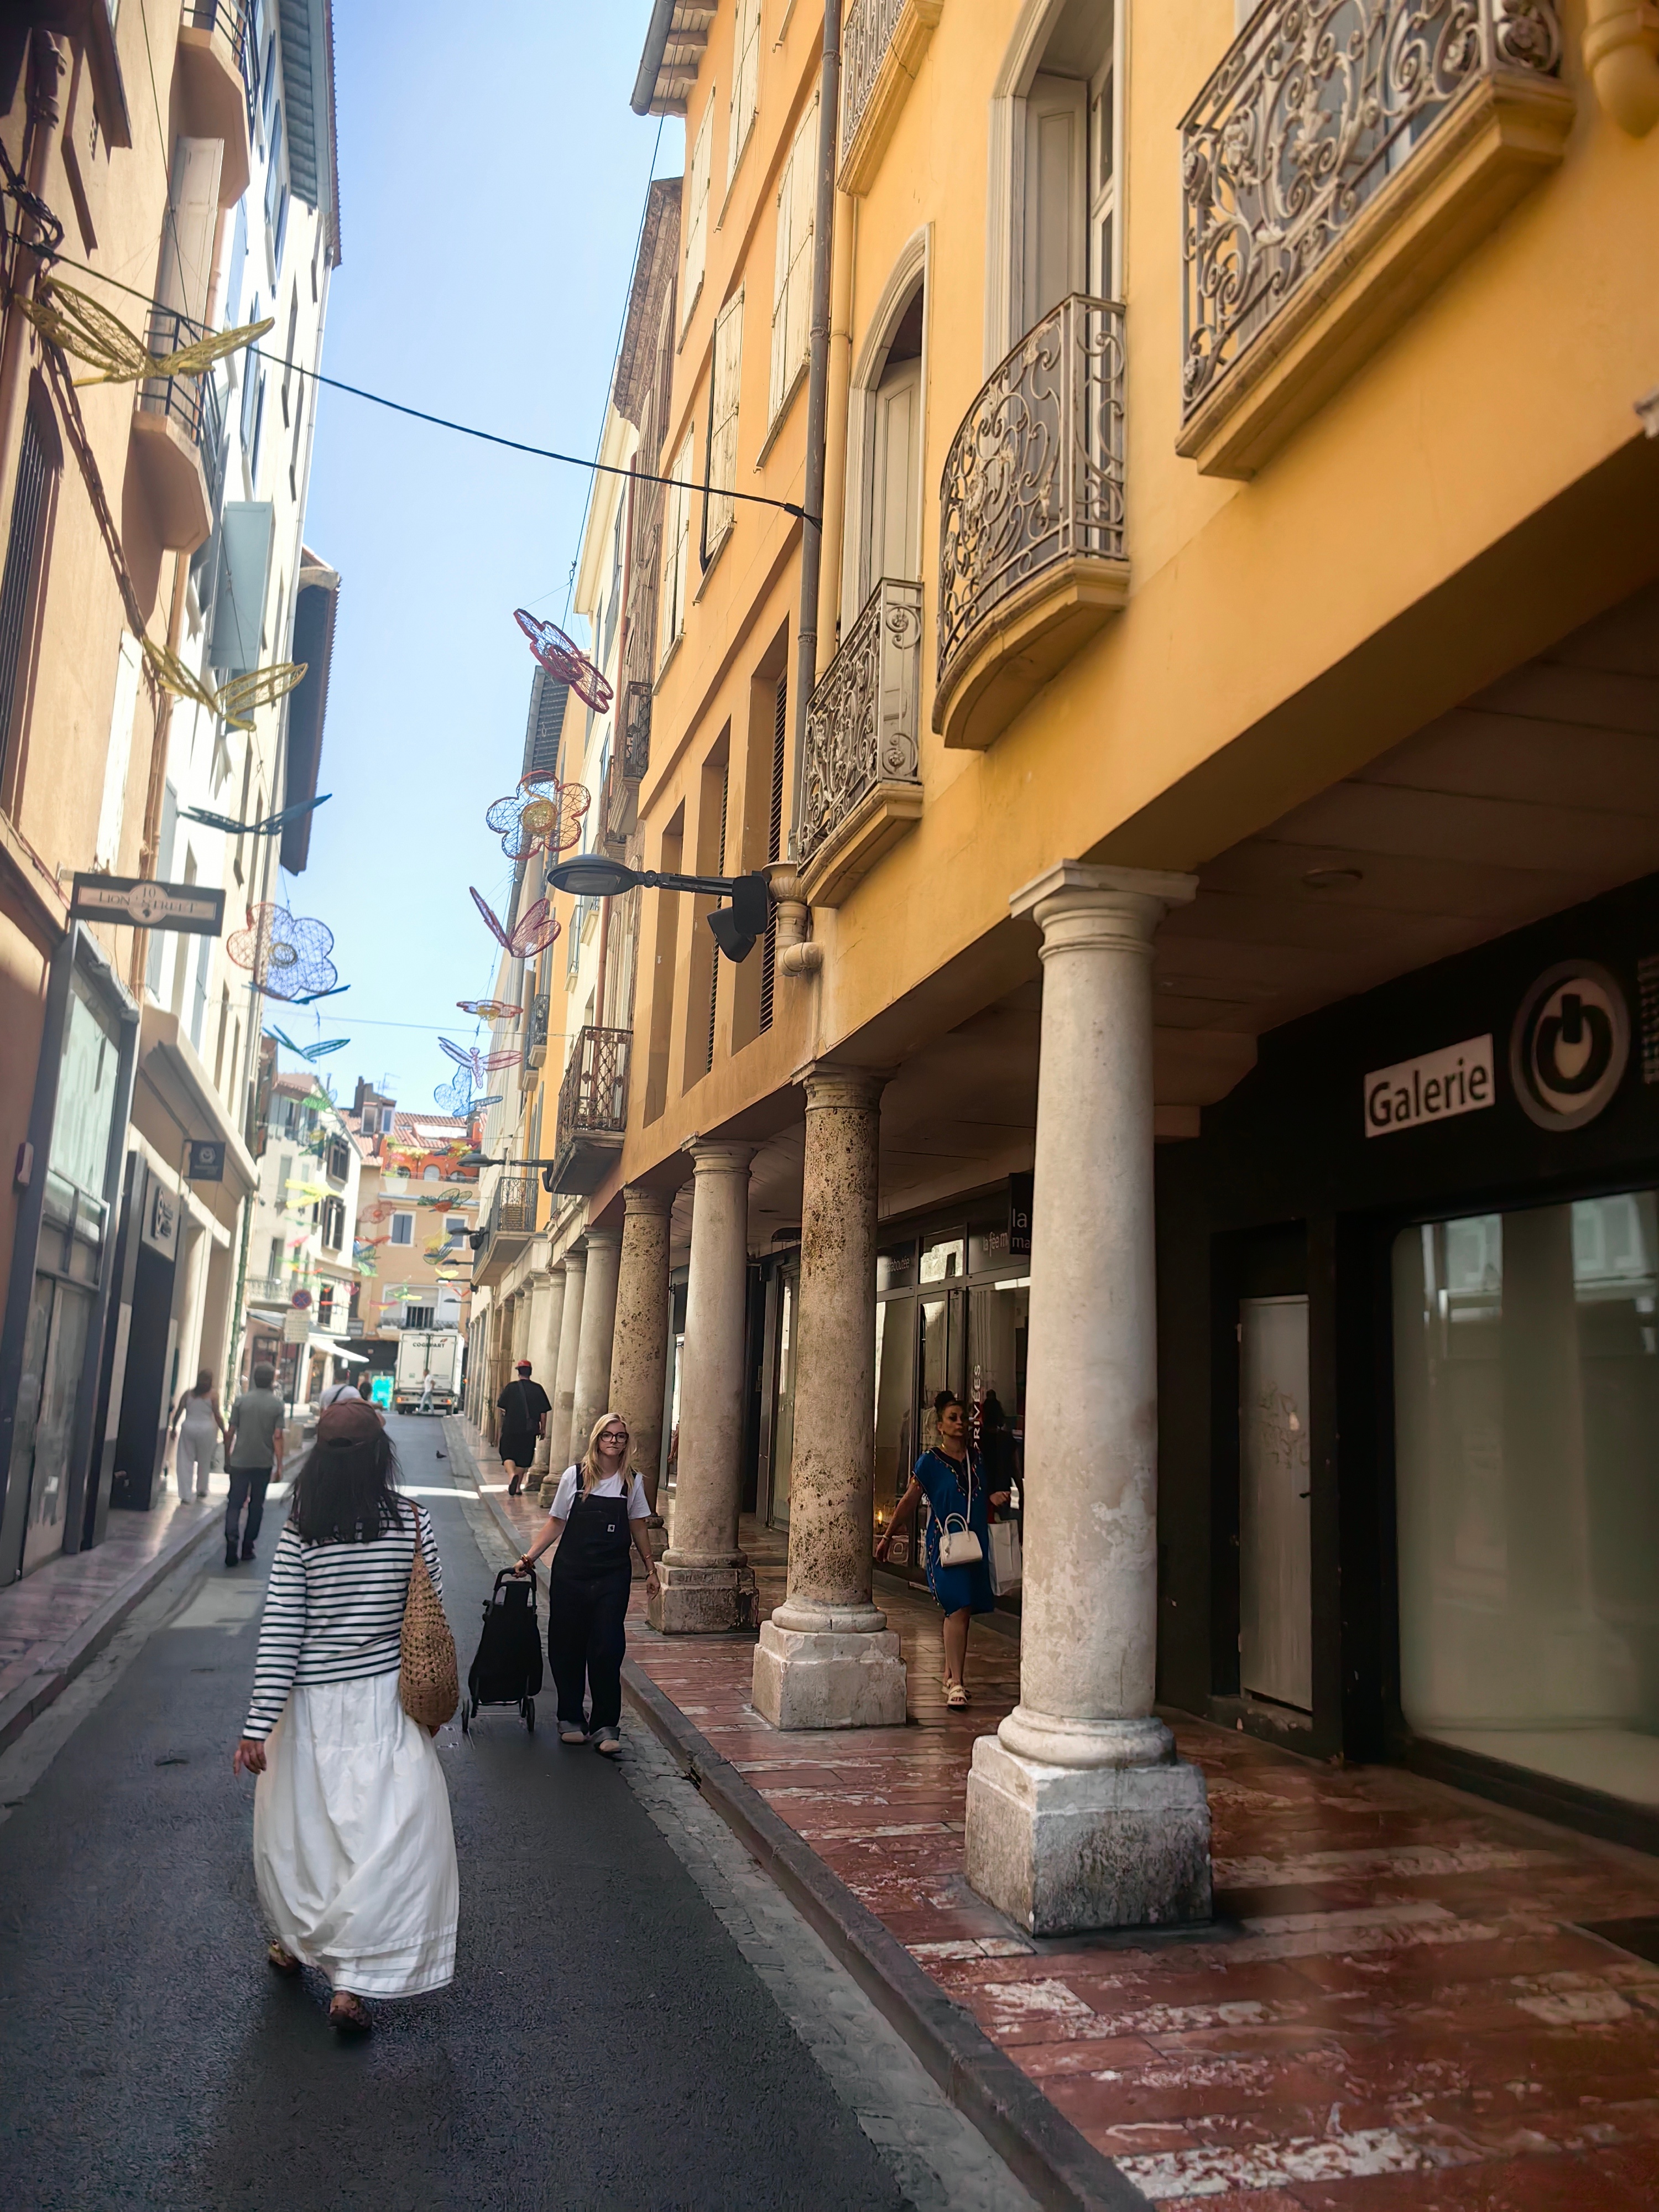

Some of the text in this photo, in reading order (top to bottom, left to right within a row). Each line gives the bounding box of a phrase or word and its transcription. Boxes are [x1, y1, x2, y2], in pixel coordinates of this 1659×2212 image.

[142, 886, 156, 899] 10
[1369, 1057, 1487, 1126] Galerie
[1013, 1208, 1027, 1228] la
